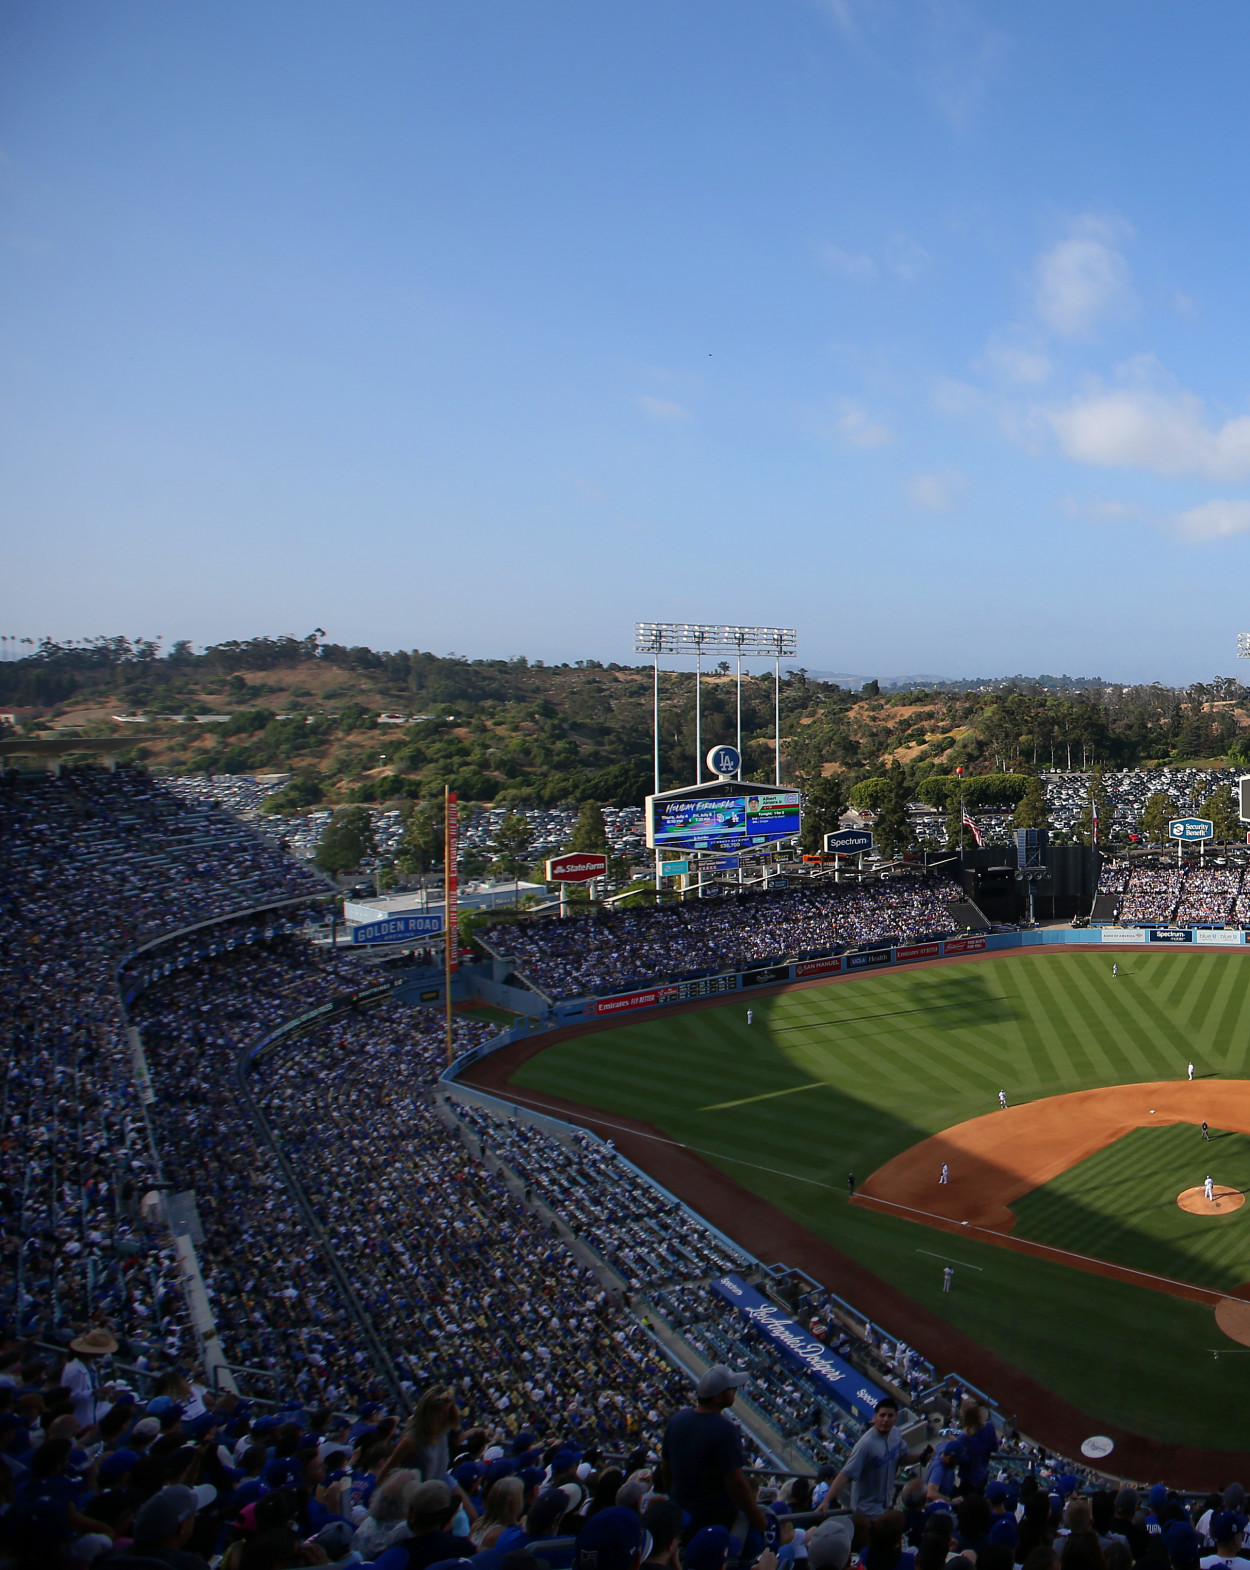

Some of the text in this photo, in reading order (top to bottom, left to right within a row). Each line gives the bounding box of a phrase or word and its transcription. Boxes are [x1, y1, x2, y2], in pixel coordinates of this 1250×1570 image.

[719, 751, 734, 771] LA
[1185, 823, 1209, 831] Security
[830, 837, 867, 848] Spectrum
[450, 838, 458, 877] Emirates
[357, 919, 439, 941] GOLDEN ROAD
[383, 931, 415, 940] BREWING
[1156, 931, 1184, 939] Spectrum
[450, 925, 458, 965] Emirates
[868, 953, 888, 963] Health
[897, 948, 919, 958] Emirates
[803, 959, 840, 971] SAN MANUEL
[598, 1000, 629, 1011] Emirates
[720, 1277, 743, 1296] Spectrum
[765, 1318, 801, 1353] Angeles
[794, 1343, 846, 1382] Dodgers
[856, 1388, 879, 1409] Spectr
